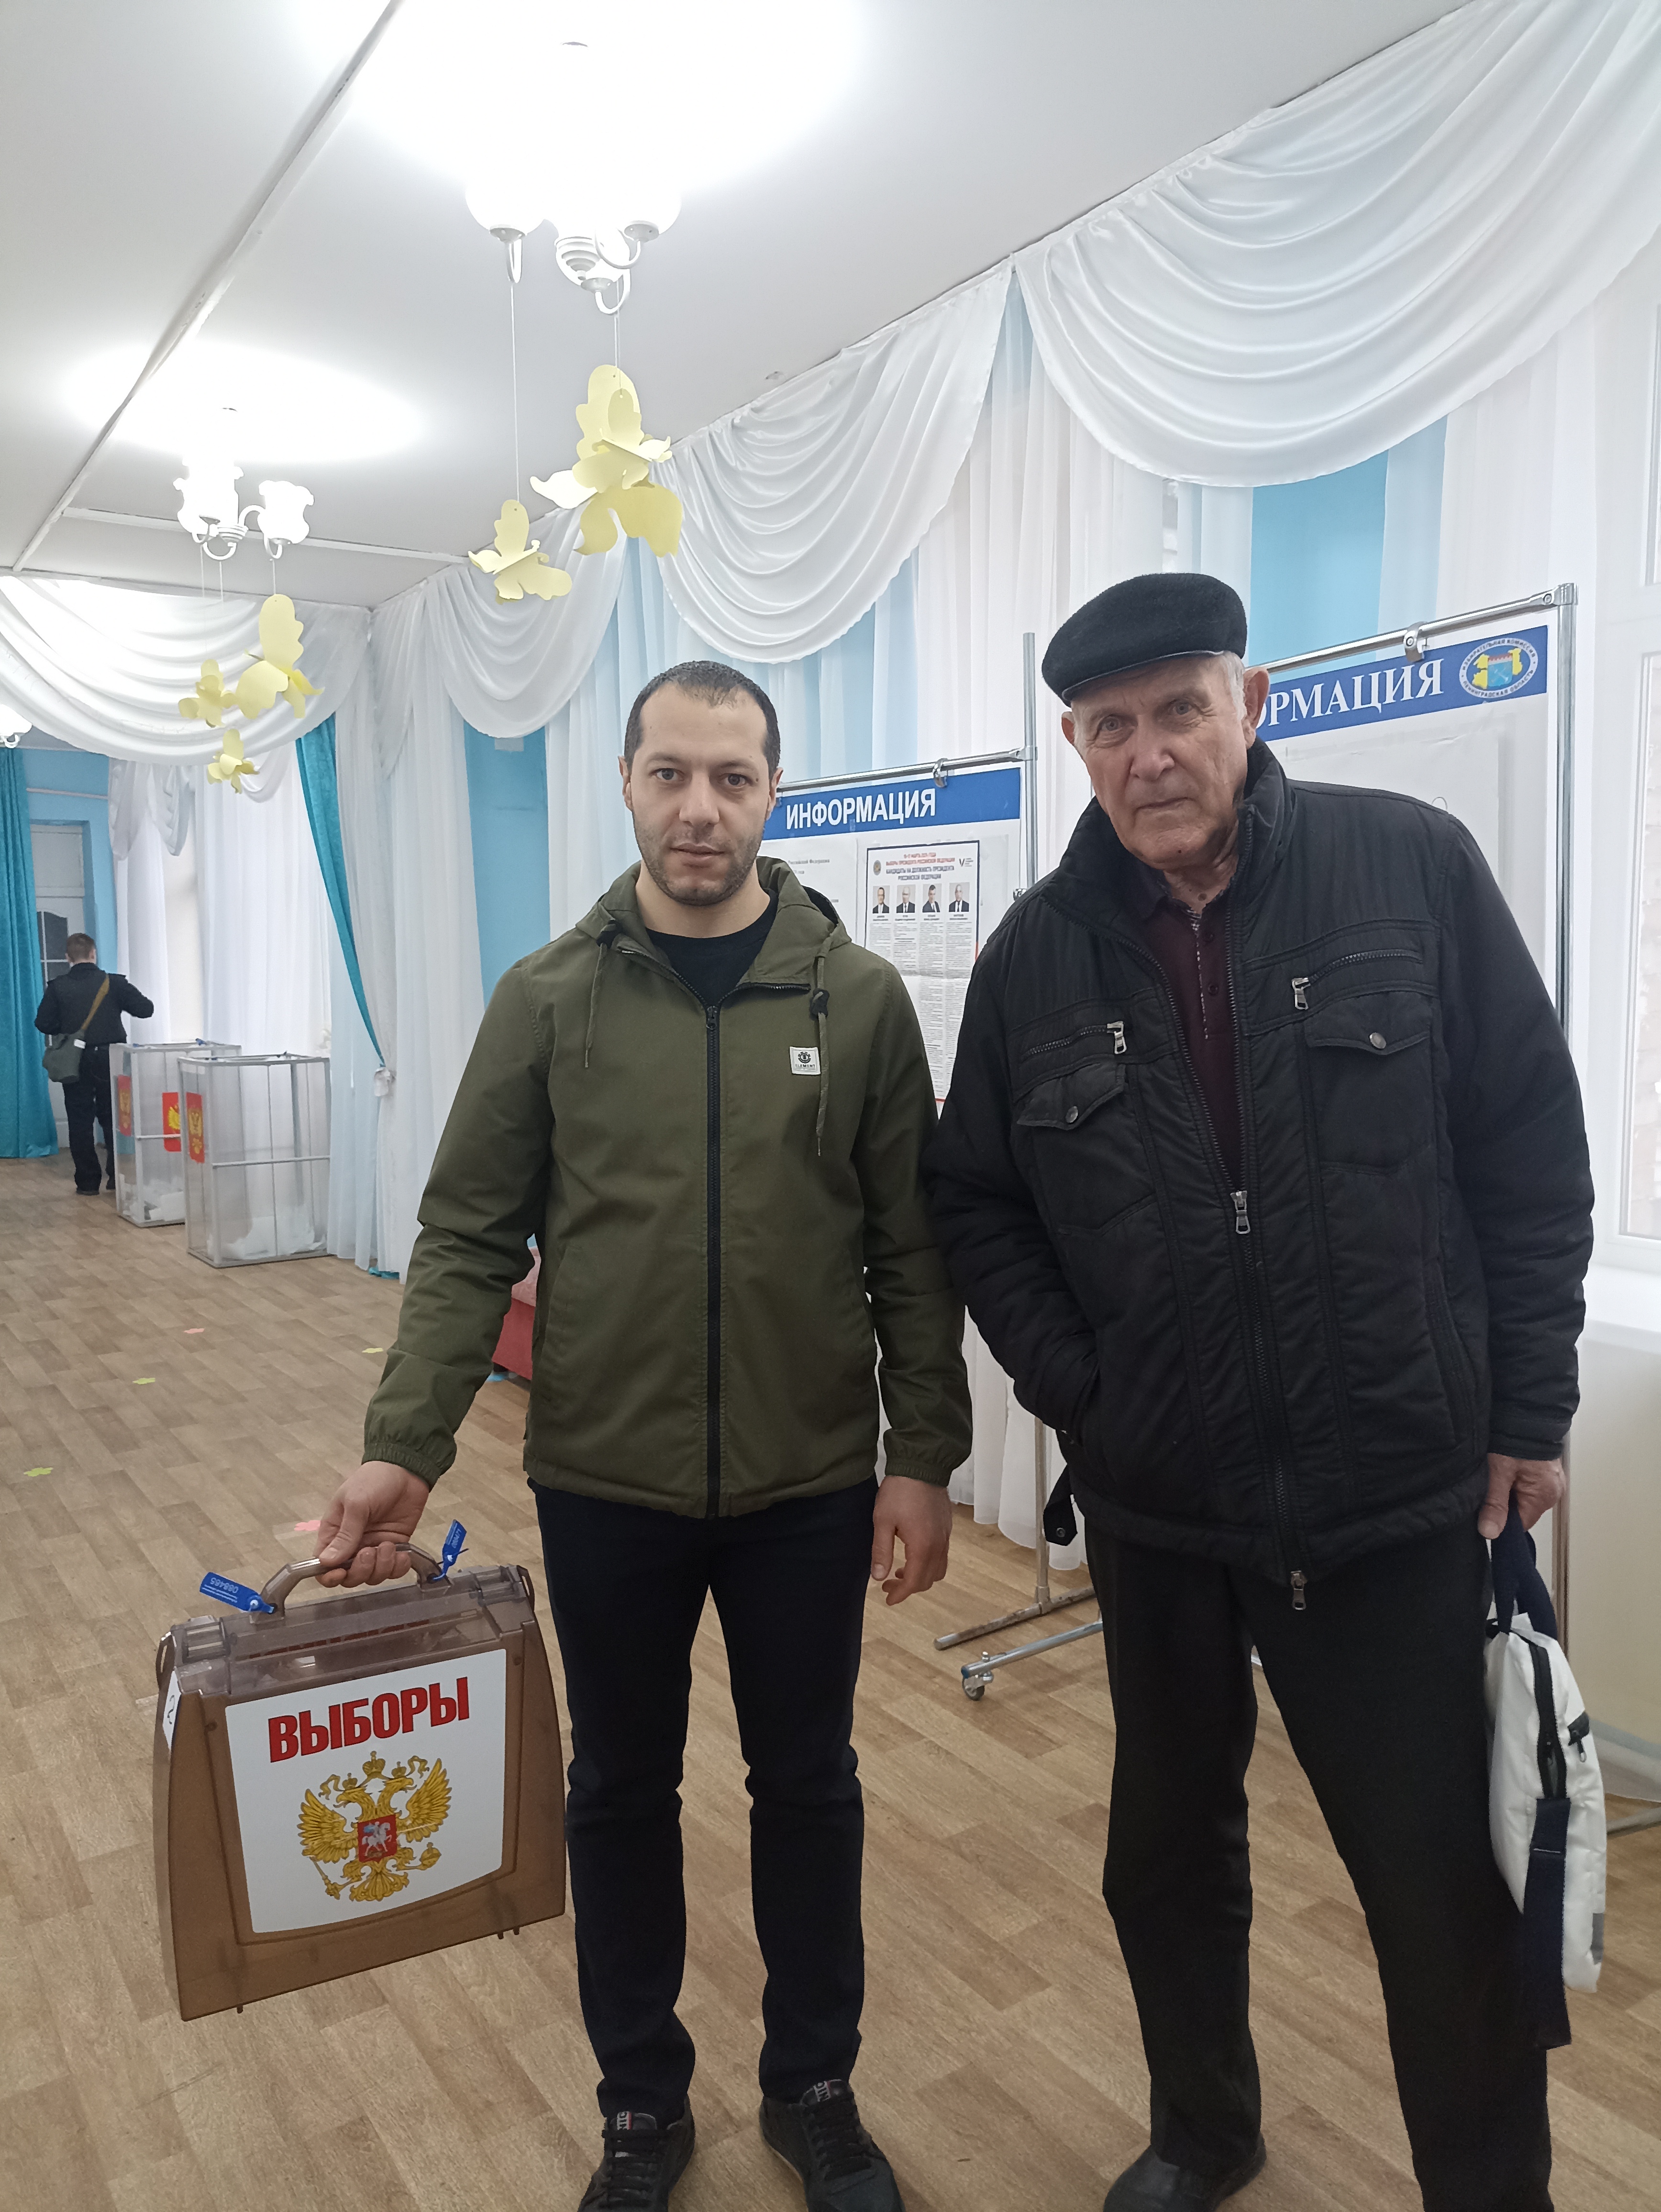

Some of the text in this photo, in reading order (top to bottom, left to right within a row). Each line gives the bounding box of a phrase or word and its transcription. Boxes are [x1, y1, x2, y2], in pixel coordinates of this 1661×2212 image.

[1507, 639, 1535, 657] КОМИССИЯ
[1510, 670, 1533, 692] ОБЛАСТЬ
[786, 788, 935, 830] ИНФОРМАЦИЯ
[267, 1677, 470, 1763] ВЫБОРЫ
